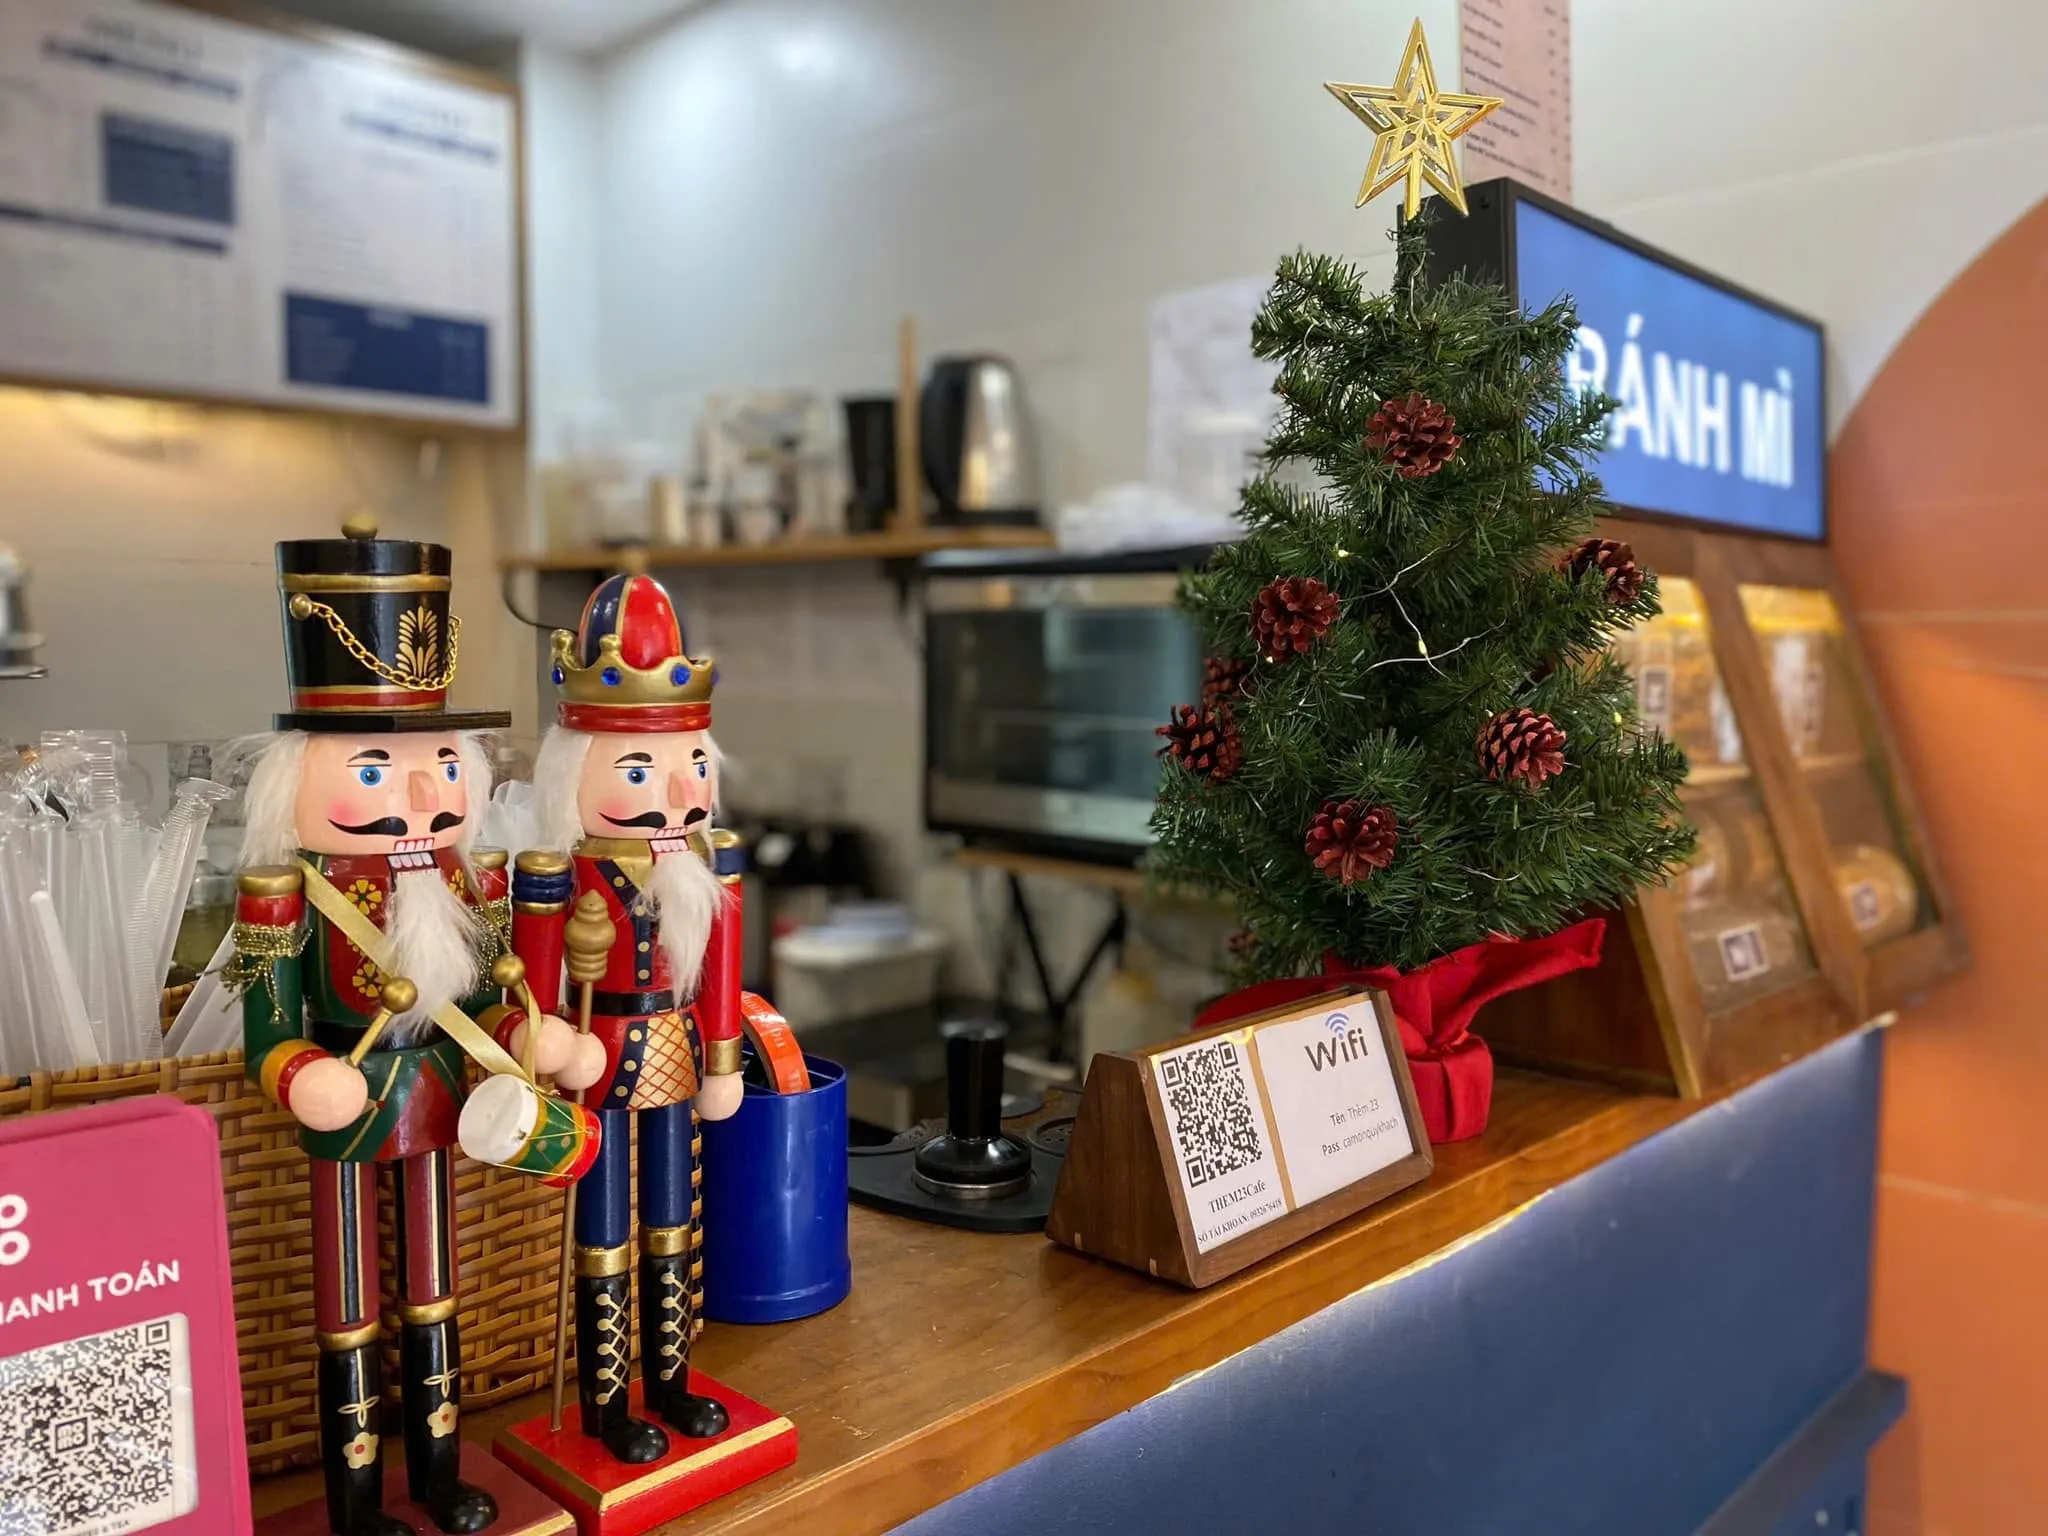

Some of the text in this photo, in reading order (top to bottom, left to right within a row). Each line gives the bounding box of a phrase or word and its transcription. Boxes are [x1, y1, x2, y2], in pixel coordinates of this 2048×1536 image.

[1566, 313, 1793, 489] BÁNH MÌ
[1304, 1027, 1369, 1072] Wifi
[0, 1260, 180, 1327] ANH TOÁN
